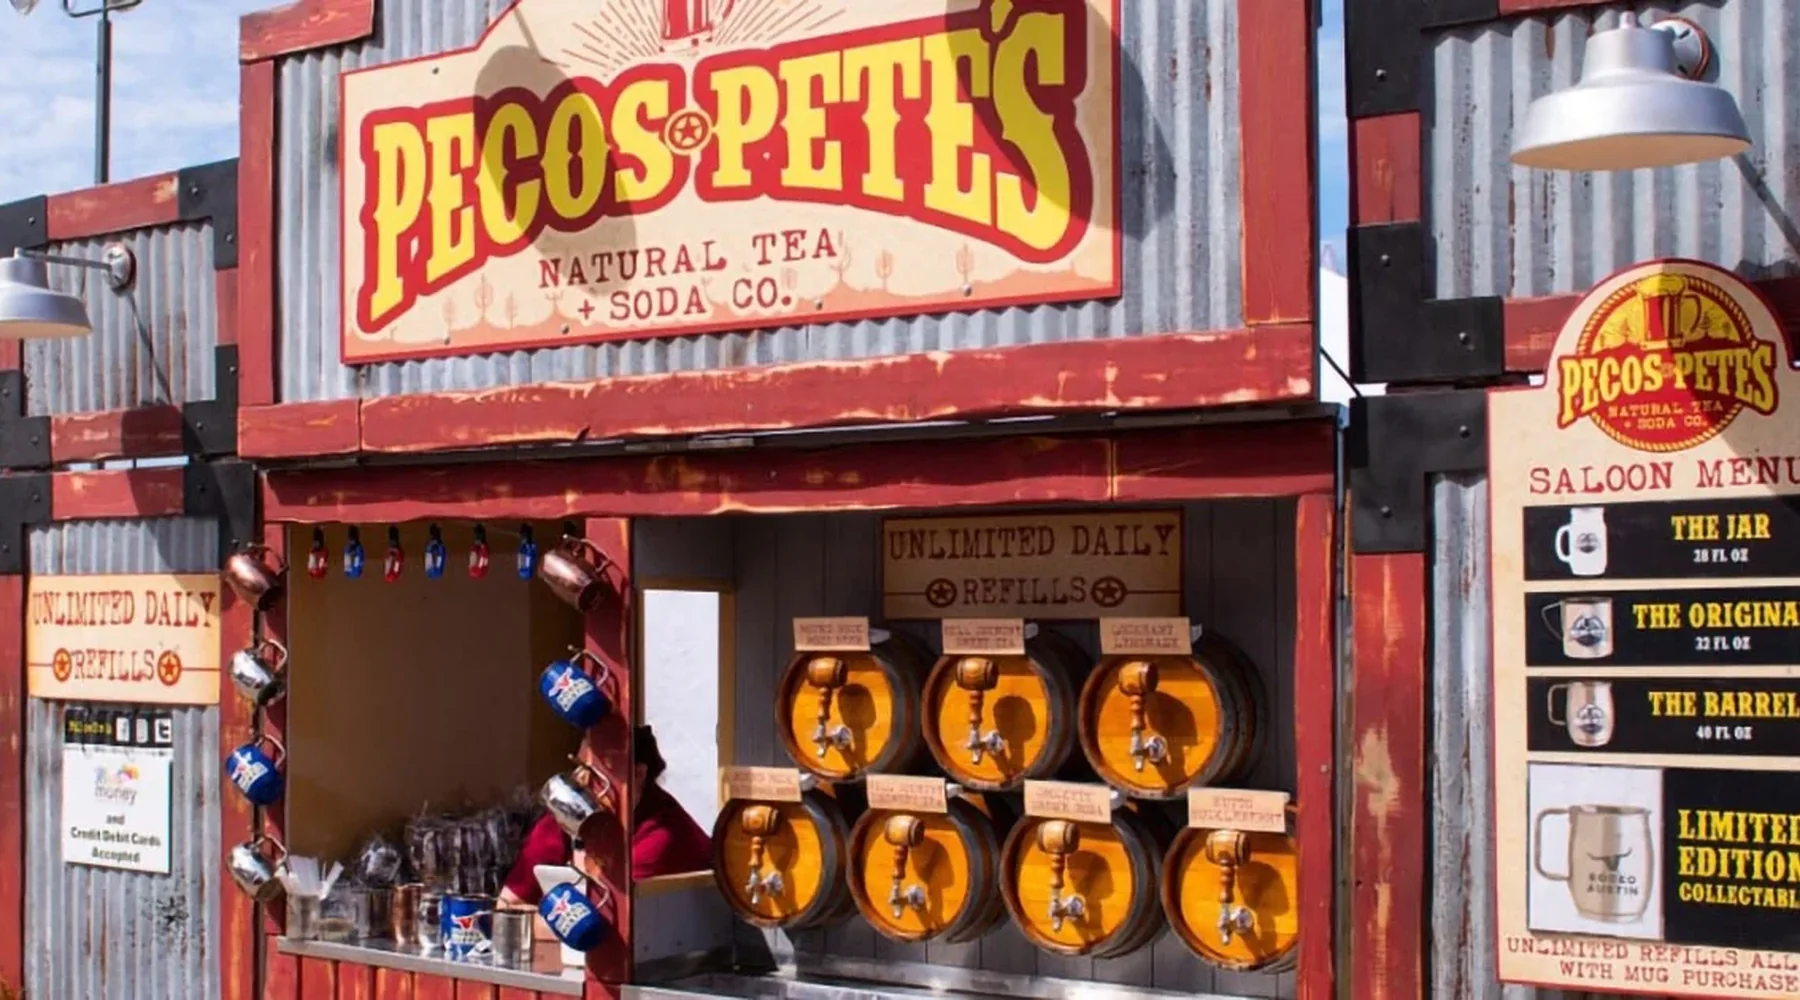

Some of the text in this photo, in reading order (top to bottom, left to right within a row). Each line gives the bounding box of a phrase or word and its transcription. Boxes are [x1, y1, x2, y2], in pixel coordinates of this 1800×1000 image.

[367, 0, 1072, 321] PECOS PETE'S
[538, 228, 837, 288] NATURAL TEA
[609, 285, 707, 321] SODA
[732, 277, 793, 309] CO.
[1561, 340, 1776, 426] PECOS PETE'S
[1608, 399, 1724, 418] NATURAL TEA
[1637, 416, 1677, 430] SODA
[1529, 456, 1800, 495] SALOON MENU
[1671, 513, 1771, 541] THE JAR
[890, 523, 1176, 560] UNLIMITED DAILY
[1711, 549, 1728, 563] FL
[1730, 548, 1749, 562] OZ
[962, 576, 1087, 605] REFILLS
[32, 590, 217, 628] UNLIMITED DAILY
[1632, 601, 1800, 629] THE ORIGINA
[1713, 636, 1730, 650] FL
[1732, 636, 1751, 650] OZ
[71, 649, 156, 682] REFILLS
[1648, 691, 1800, 718] THE BARREL
[1715, 726, 1731, 740] FL
[1734, 726, 1753, 740] OZ
[106, 813, 126, 826] and
[131, 832, 162, 847] Cards
[91, 846, 141, 863] Accepted
[1586, 883, 1639, 896] AUSTIN
[1678, 882, 1800, 909] COLLECTABL
[1507, 936, 1799, 971] UNLIMITED REFILLS ALL
[1559, 960, 1800, 993] WITH MUG PURCHASE
